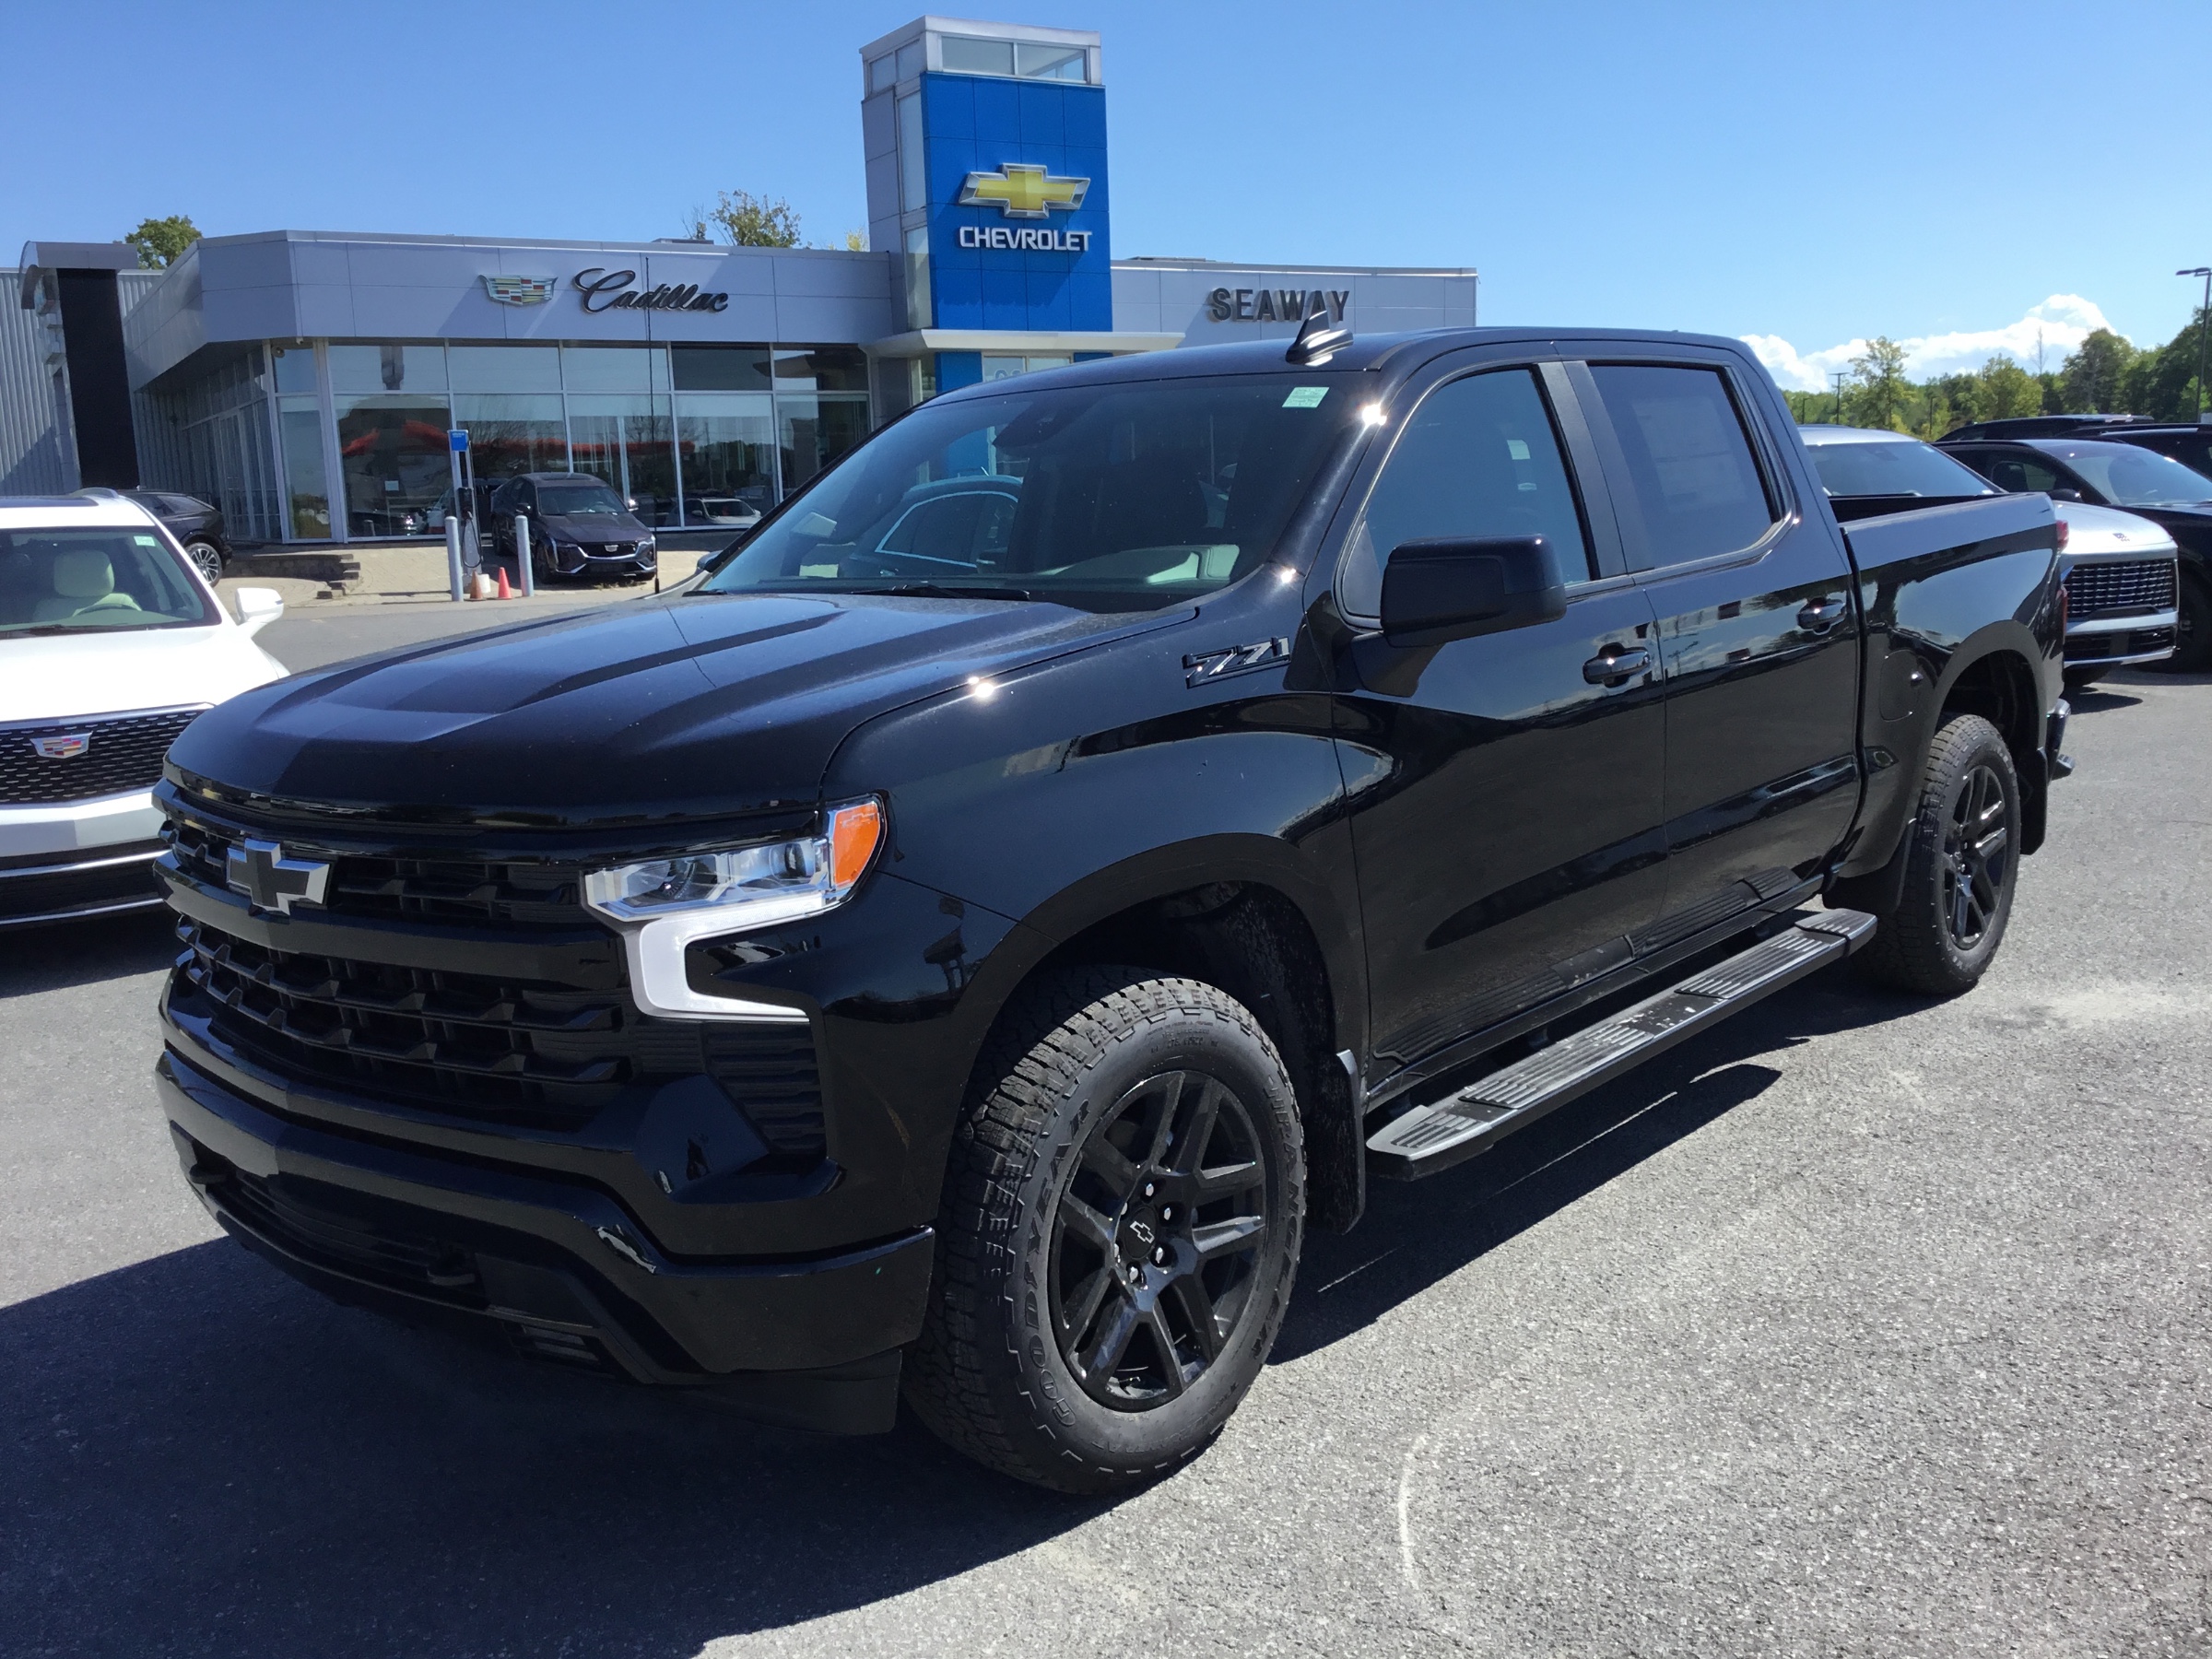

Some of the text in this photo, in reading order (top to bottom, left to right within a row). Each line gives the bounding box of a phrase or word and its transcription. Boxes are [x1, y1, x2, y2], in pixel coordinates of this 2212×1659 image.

[959, 225, 1093, 252] CHEVROLET
[573, 266, 729, 314] Cadillac
[1209, 287, 1350, 323] SEAWAY
[1181, 636, 1291, 689] Z71
[1023, 1099, 1091, 1427] GOODYEAR
